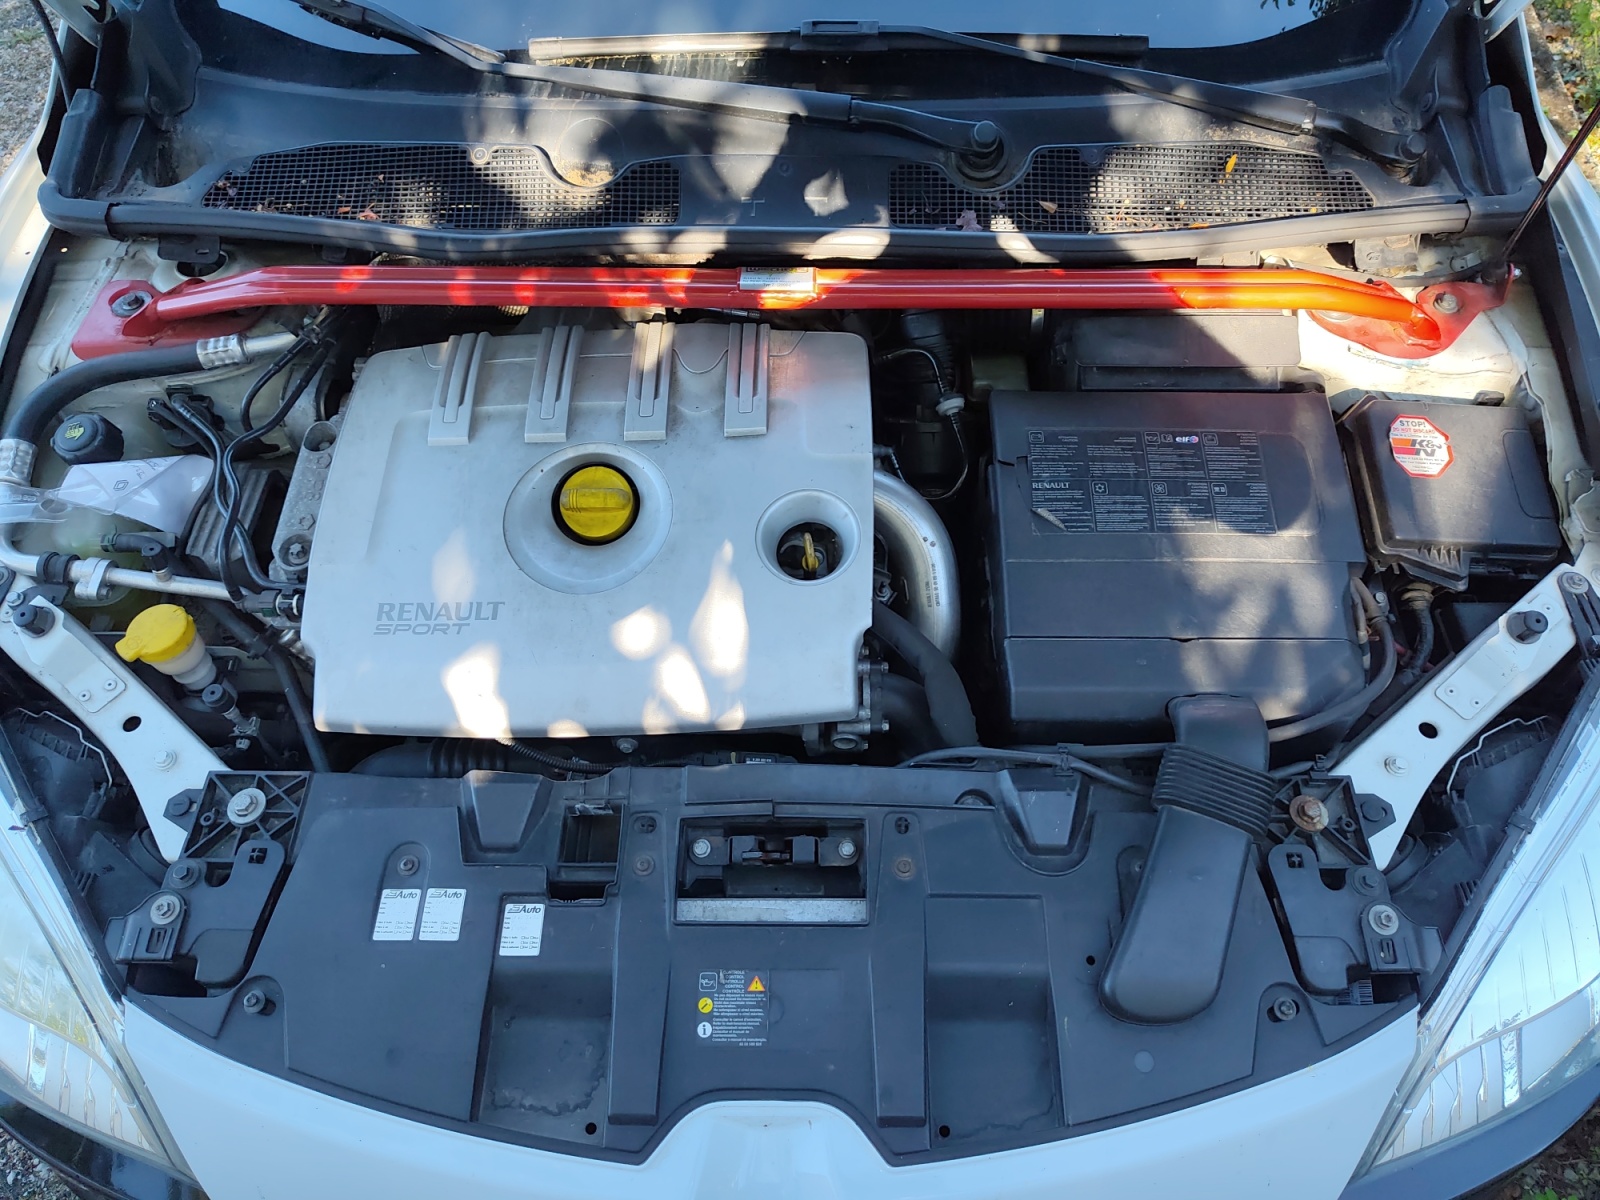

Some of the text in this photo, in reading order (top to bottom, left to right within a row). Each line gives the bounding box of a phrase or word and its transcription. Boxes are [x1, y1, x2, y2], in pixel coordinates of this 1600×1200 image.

[1399, 420, 1426, 428] STOP!
[376, 602, 505, 621] RENAULT
[373, 623, 470, 635] SPORT
